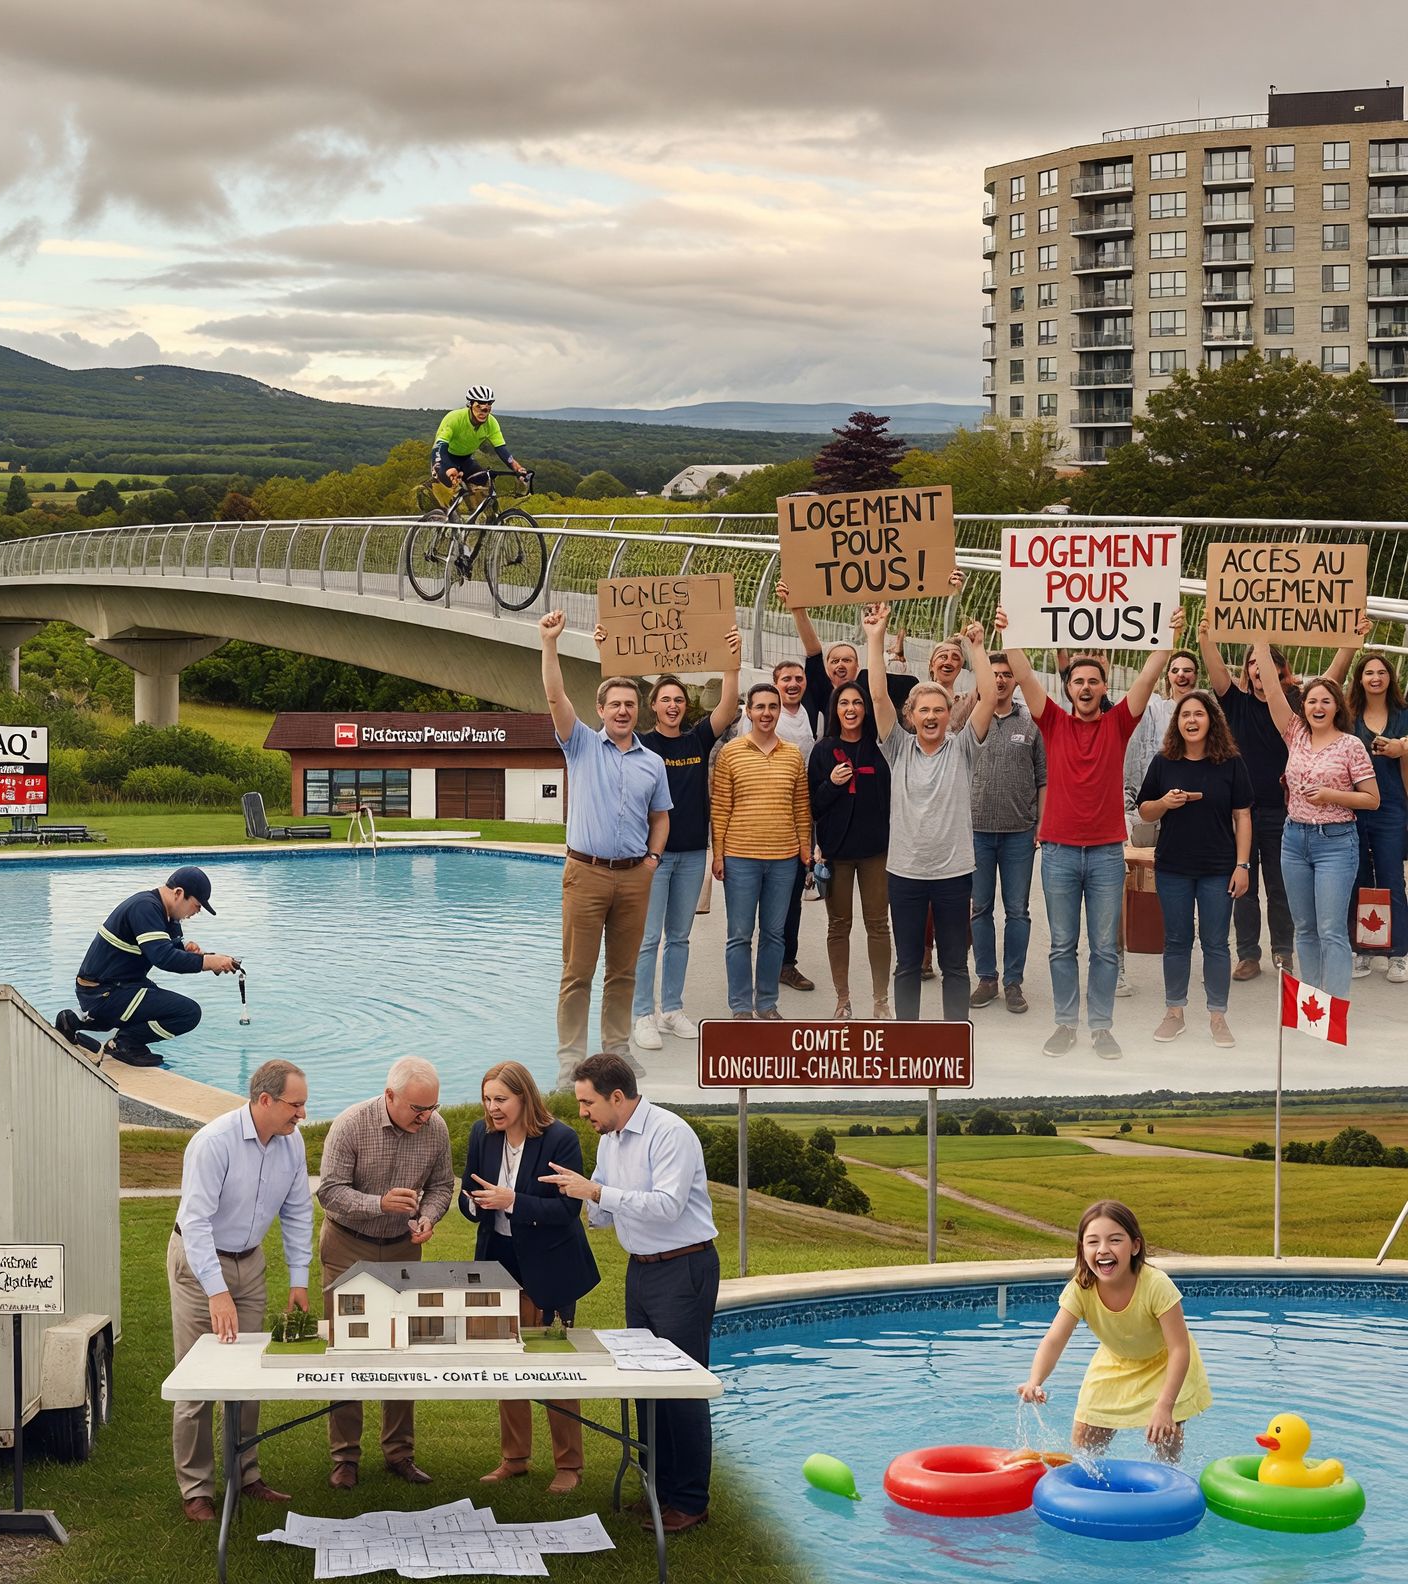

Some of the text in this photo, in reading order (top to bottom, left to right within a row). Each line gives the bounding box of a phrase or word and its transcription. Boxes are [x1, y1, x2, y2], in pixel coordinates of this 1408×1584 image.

[789, 492, 943, 533] LOGEMENT
[832, 527, 903, 559] POUR
[1009, 533, 1177, 569] LOGEMENT
[815, 550, 926, 597] TOUS!
[1312, 550, 1345, 575] AU
[1045, 571, 1129, 603] POUR
[1219, 578, 1354, 604] LOGEMENT
[1040, 602, 1161, 645] TOUS!
[1215, 606, 1362, 635] MAINTENANT!
[791, 1026, 885, 1051] COMTÉ DE
[708, 1056, 965, 1080] LONGUEUIL-CHARLES-LEMOYNE
[493, 1372, 510, 1381] DE
